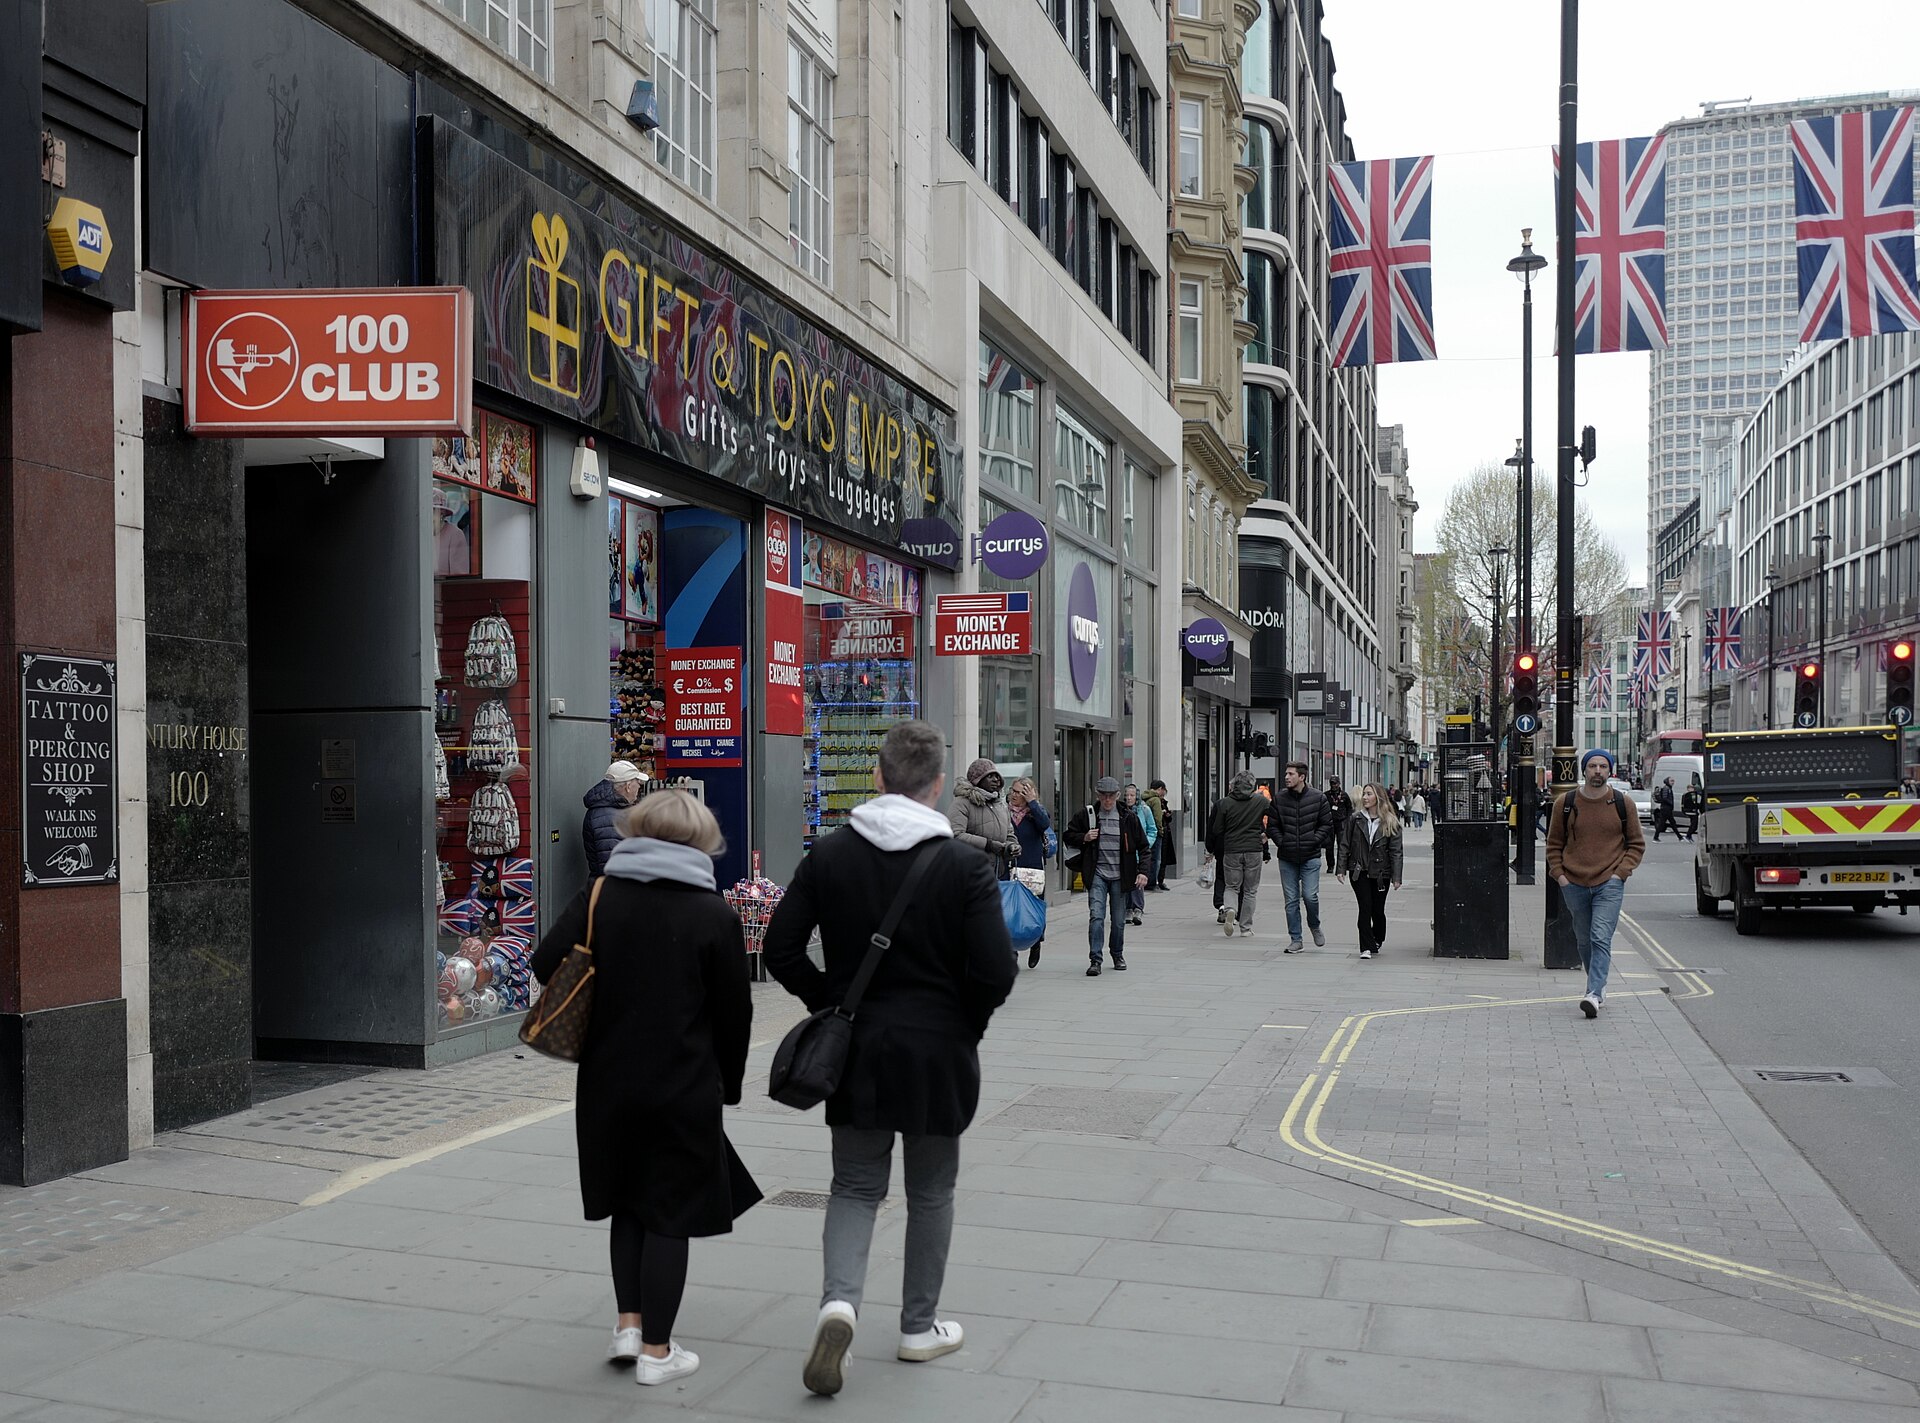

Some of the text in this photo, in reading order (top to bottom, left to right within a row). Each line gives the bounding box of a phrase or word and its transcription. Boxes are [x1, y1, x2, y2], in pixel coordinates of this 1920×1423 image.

[79, 224, 102, 248] ADT
[325, 314, 409, 354] 100
[600, 249, 700, 380] GIFT
[712, 323, 736, 395] &
[748, 332, 836, 453] TOYS
[300, 362, 440, 402] CLUB
[685, 395, 738, 455] Gifts
[766, 433, 806, 491] Toys
[828, 463, 895, 526] Luggages
[985, 537, 1043, 555] currys
[957, 615, 1007, 633] MONEY
[1240, 609, 1285, 629] NDORA
[944, 633, 1020, 651] EXCHANGE
[1071, 615, 1099, 654] currys
[1187, 633, 1225, 646] currys
[774, 640, 796, 663] MONEY
[466, 658, 495, 677] CITY
[671, 659, 736, 671] MONEY EXCHANGE
[696, 678, 712, 688] 0%
[768, 662, 801, 687] EXCHANGE
[673, 678, 684, 694] €
[724, 677, 734, 693] $
[28, 700, 108, 722] TATTOO
[680, 702, 726, 716] BEST RATE
[64, 722, 76, 740] &
[675, 718, 731, 731] GUARANTEED
[203, 726, 247, 751] HOUSE
[716, 739, 735, 747] CHANGE
[28, 740, 110, 759] PIERCING
[682, 749, 703, 757] WECHSEL
[42, 763, 95, 782] SHOP
[169, 771, 209, 807] 100
[45, 810, 97, 822] WALK INS
[44, 826, 98, 838] WELCOME
[1835, 872, 1885, 882] BF22 BJZ
